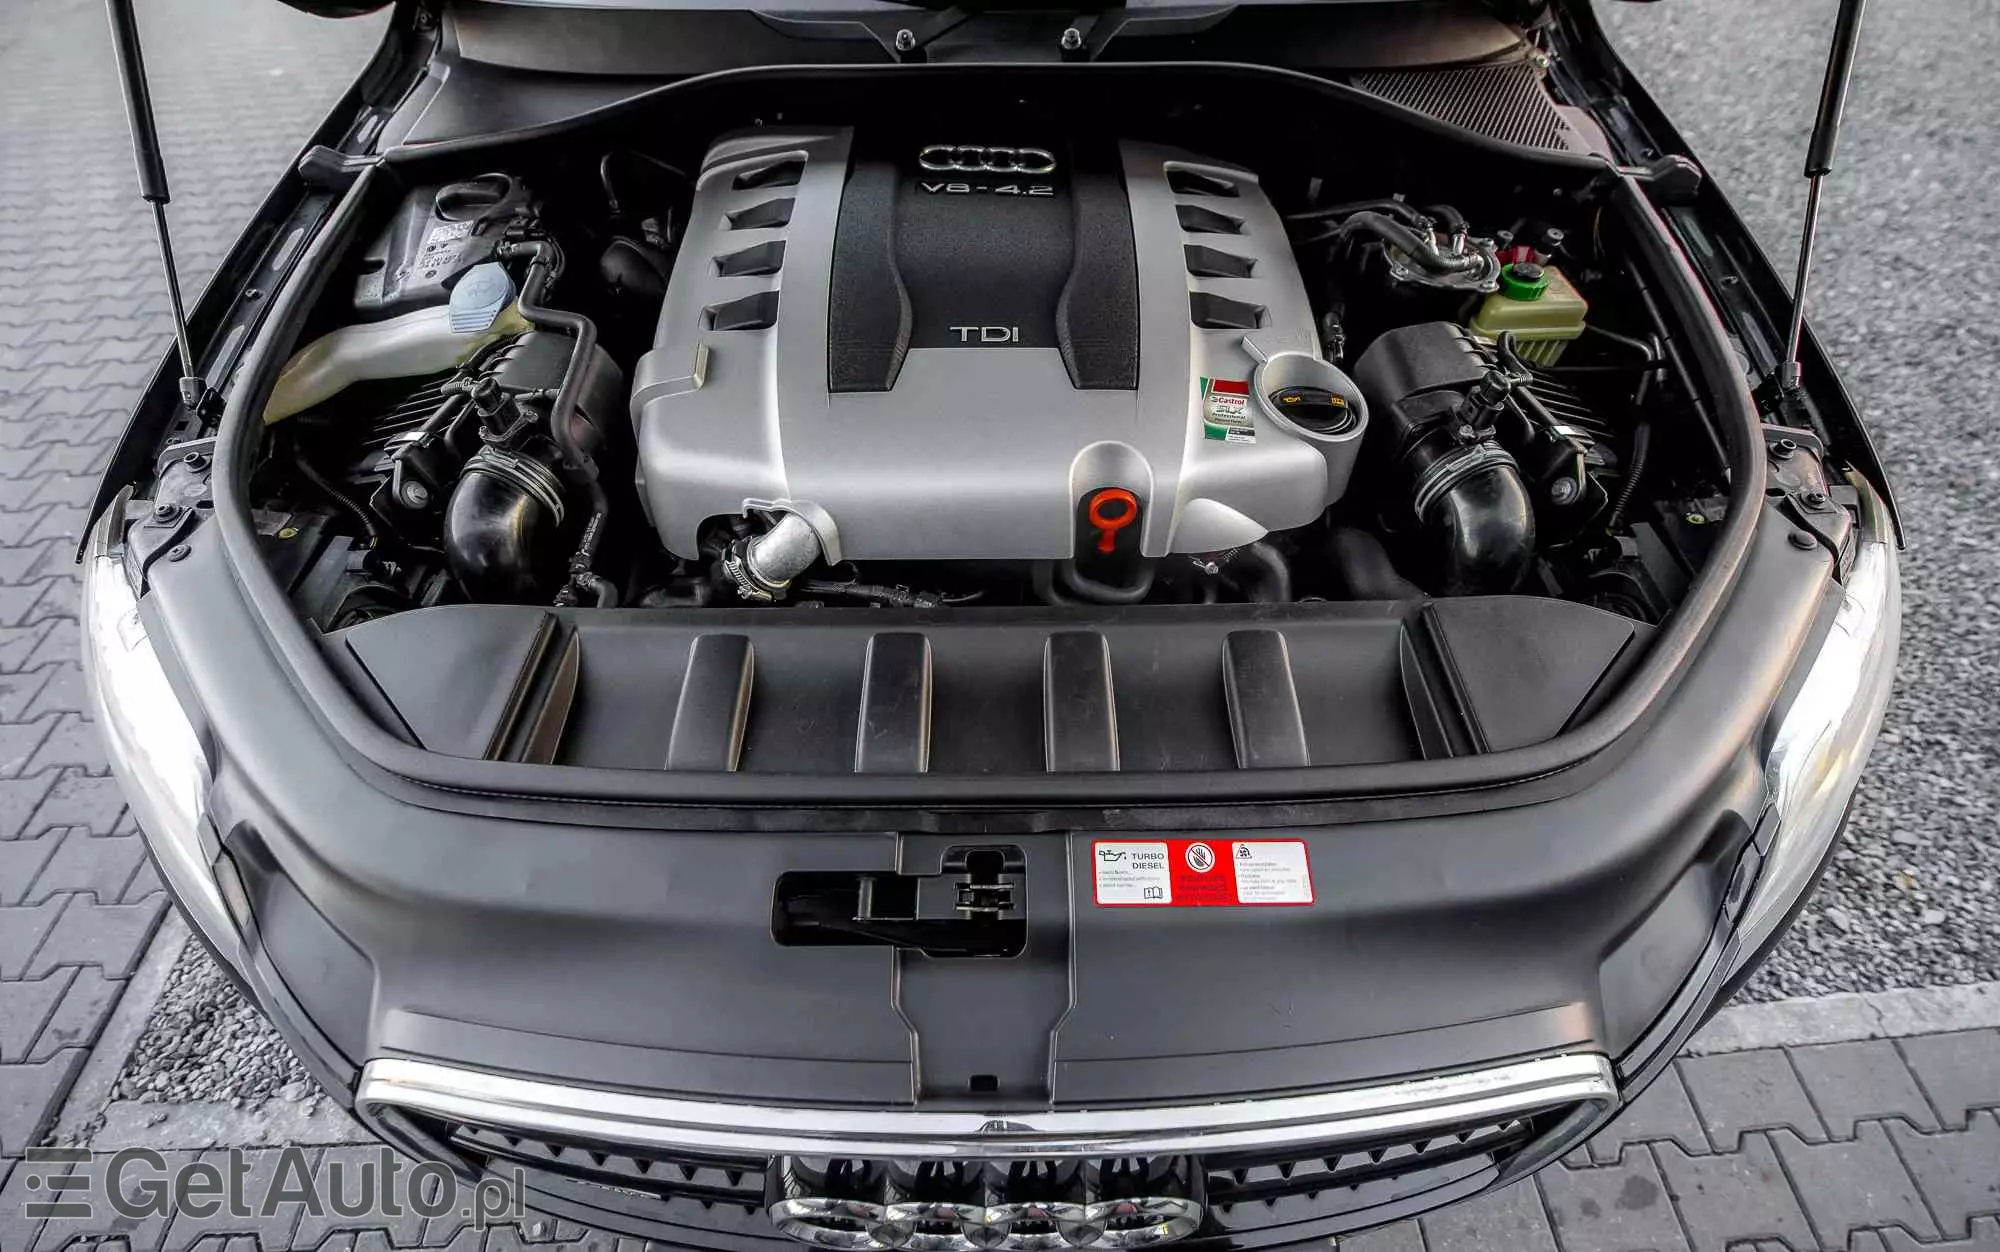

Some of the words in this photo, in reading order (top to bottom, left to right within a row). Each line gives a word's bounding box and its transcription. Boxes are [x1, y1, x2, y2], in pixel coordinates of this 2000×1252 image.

[949, 326, 1019, 342] TDI
[1218, 397, 1245, 405] Castrol
[1131, 852, 1165, 861] TURBO
[1132, 862, 1165, 870] DIESEL
